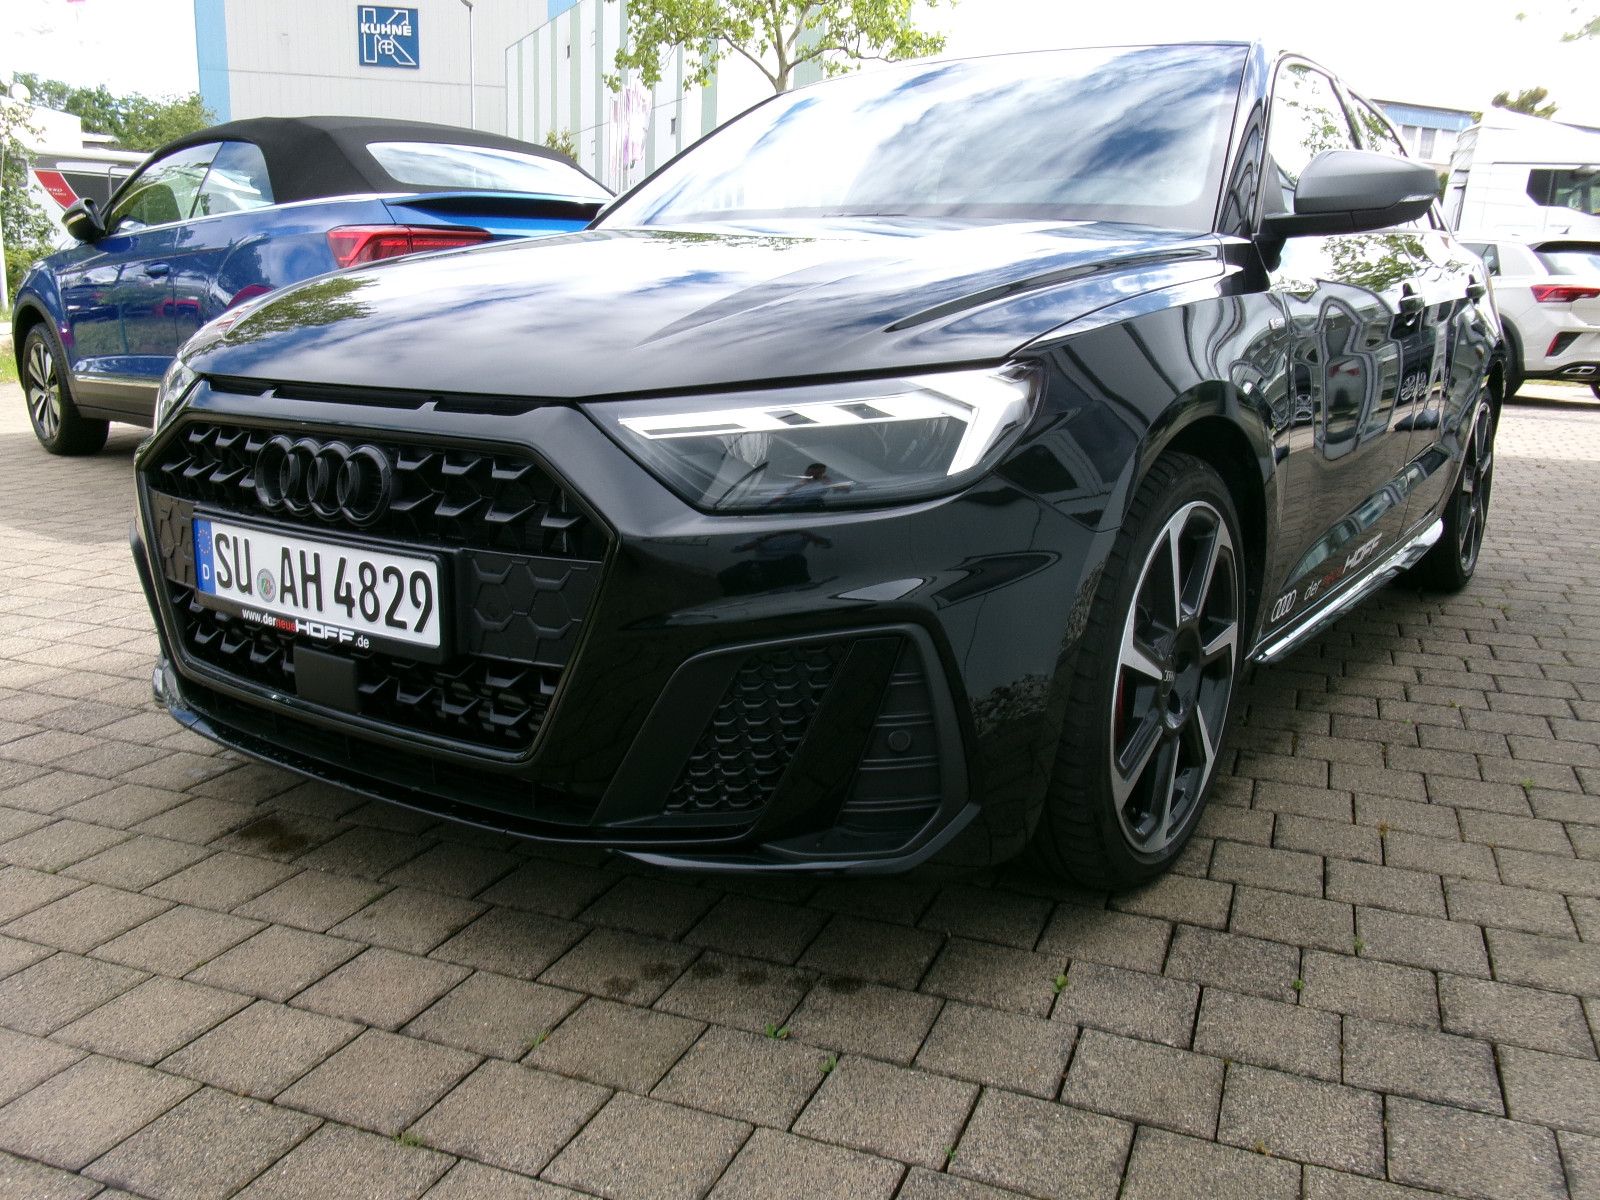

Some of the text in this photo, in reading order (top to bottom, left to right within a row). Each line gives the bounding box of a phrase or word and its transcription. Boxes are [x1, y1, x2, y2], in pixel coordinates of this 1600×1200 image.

[203, 563, 210, 580] D
[214, 532, 433, 633] SU AH 4829
